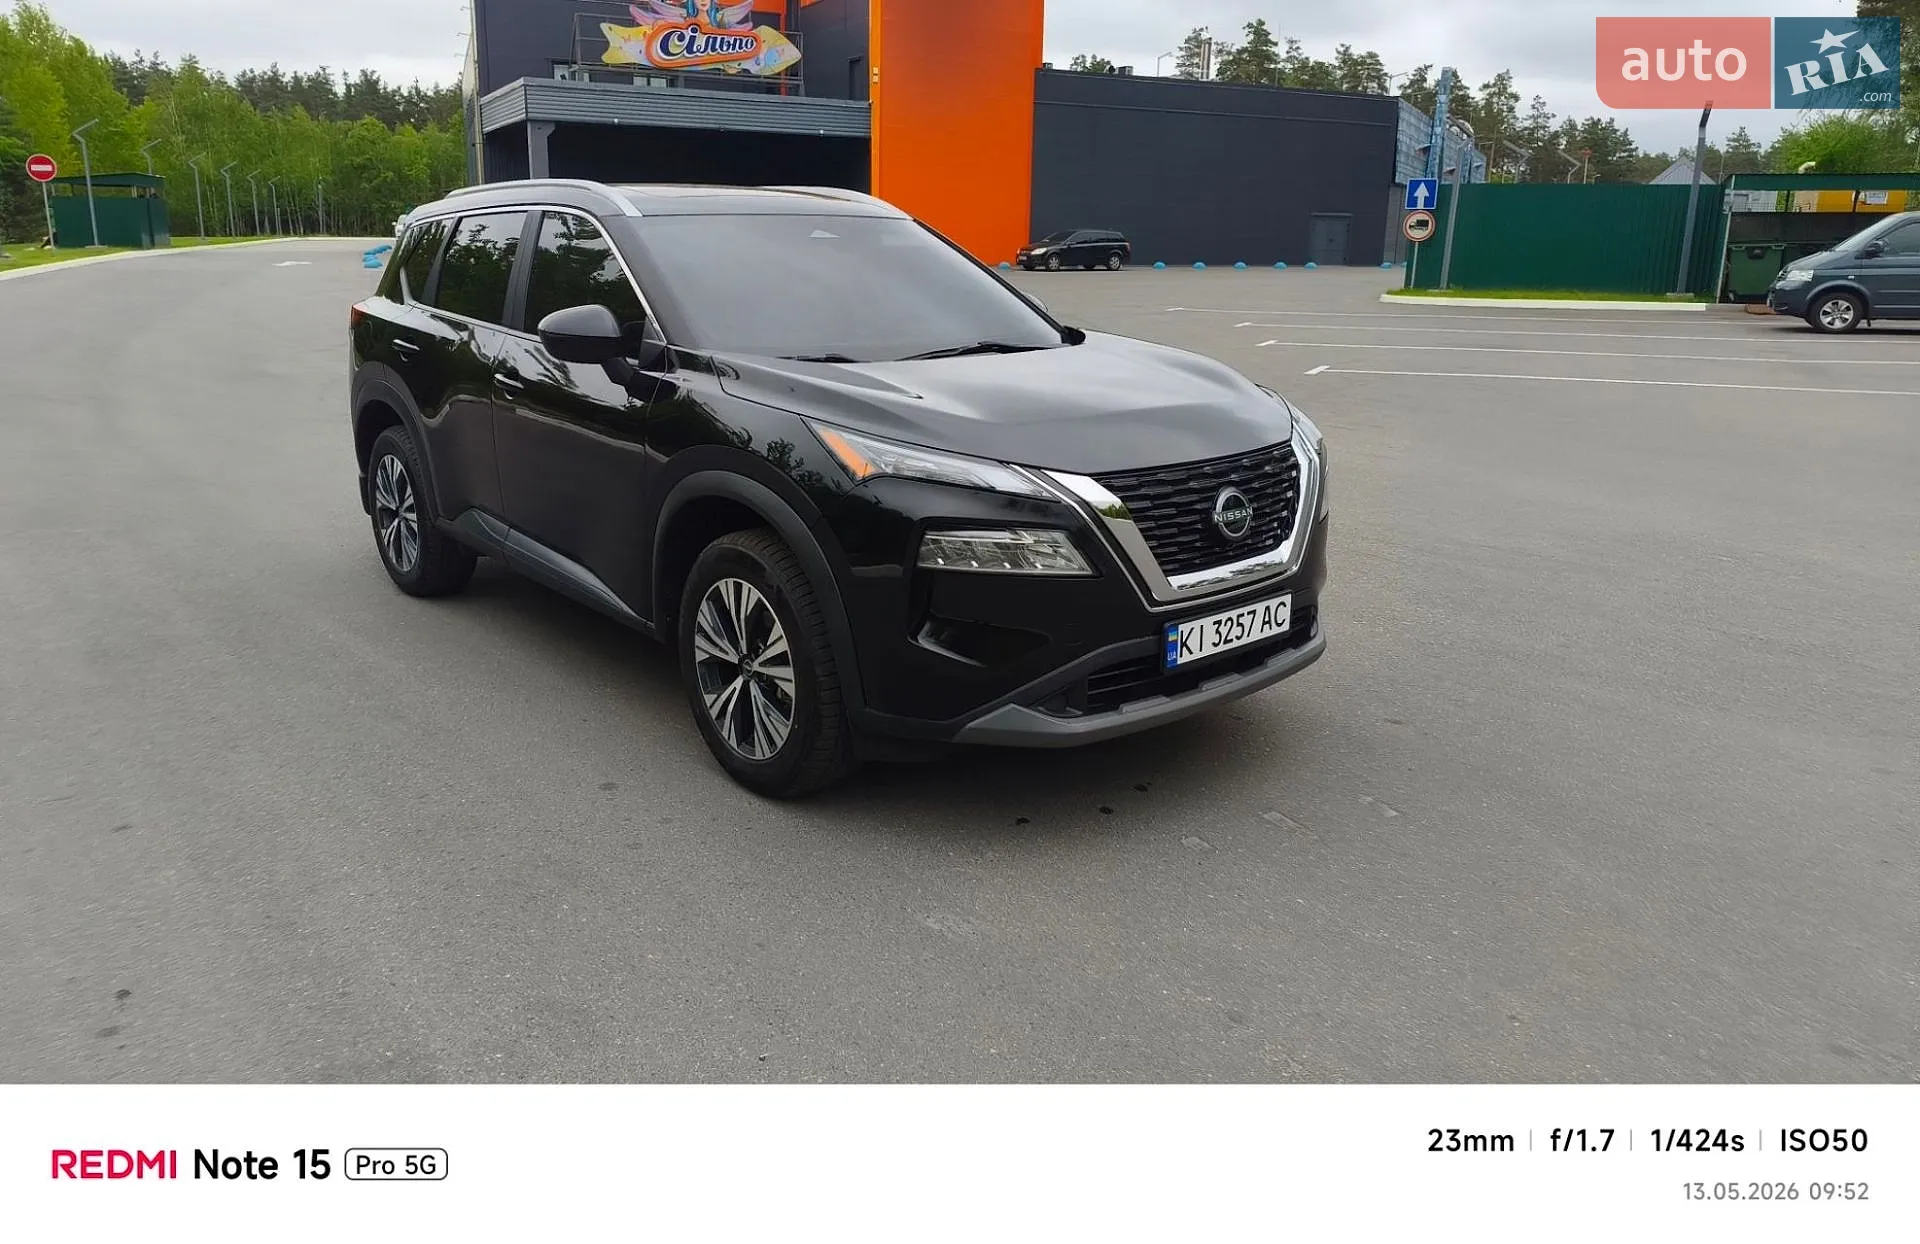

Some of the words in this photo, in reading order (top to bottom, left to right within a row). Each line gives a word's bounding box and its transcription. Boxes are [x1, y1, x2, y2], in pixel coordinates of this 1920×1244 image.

[659, 27, 755, 57] Сільпо
[1214, 507, 1253, 522] NISSAN
[1179, 624, 1204, 658] KI
[1211, 609, 1257, 647] 3257
[1260, 601, 1287, 632] AC
[1167, 651, 1177, 661] UA
